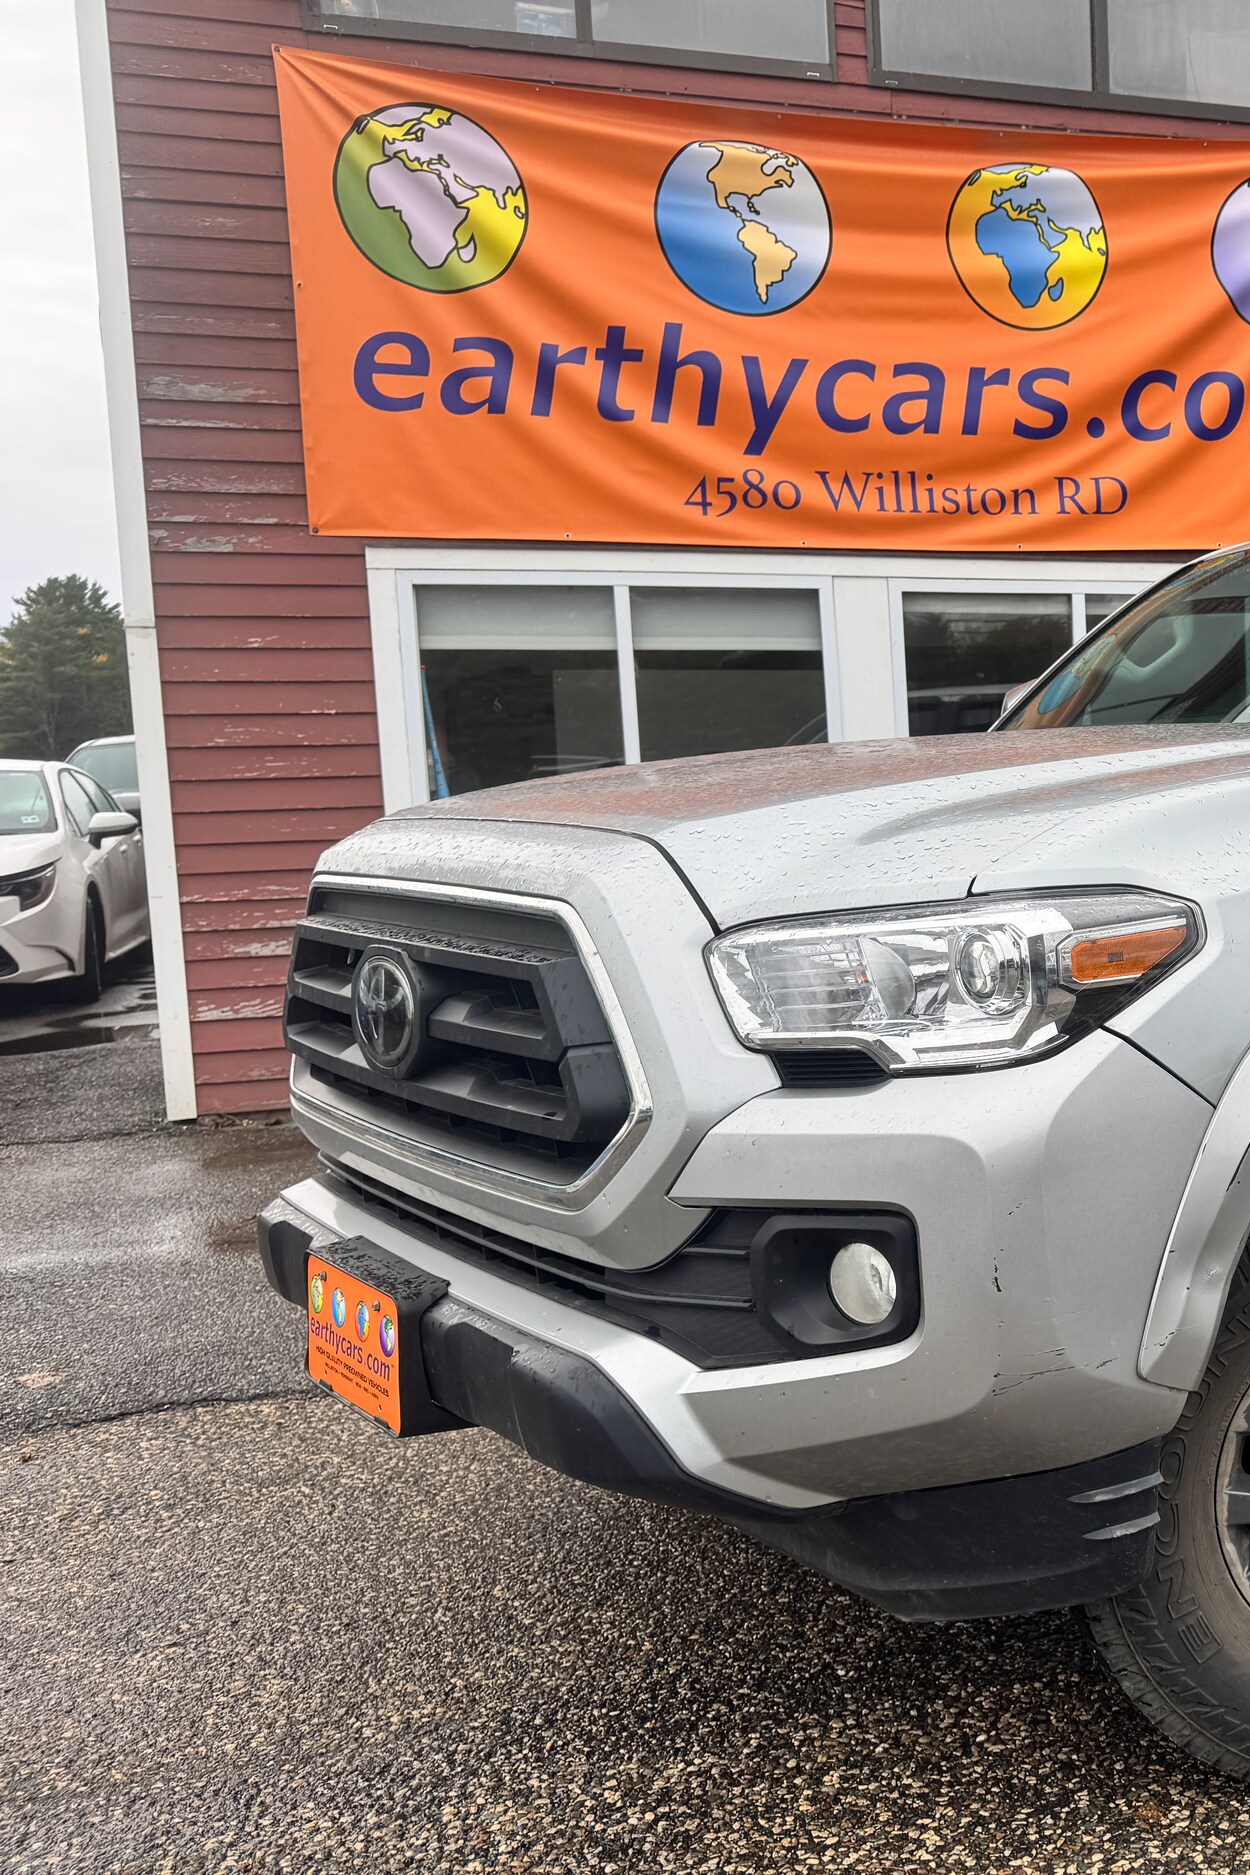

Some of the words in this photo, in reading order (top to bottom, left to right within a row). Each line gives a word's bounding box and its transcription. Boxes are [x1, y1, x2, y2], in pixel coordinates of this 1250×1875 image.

[684, 470, 802, 516] 4580
[815, 470, 1036, 515] Williston
[1055, 477, 1129, 516] RD
[311, 1317, 390, 1381] earthycars.com
